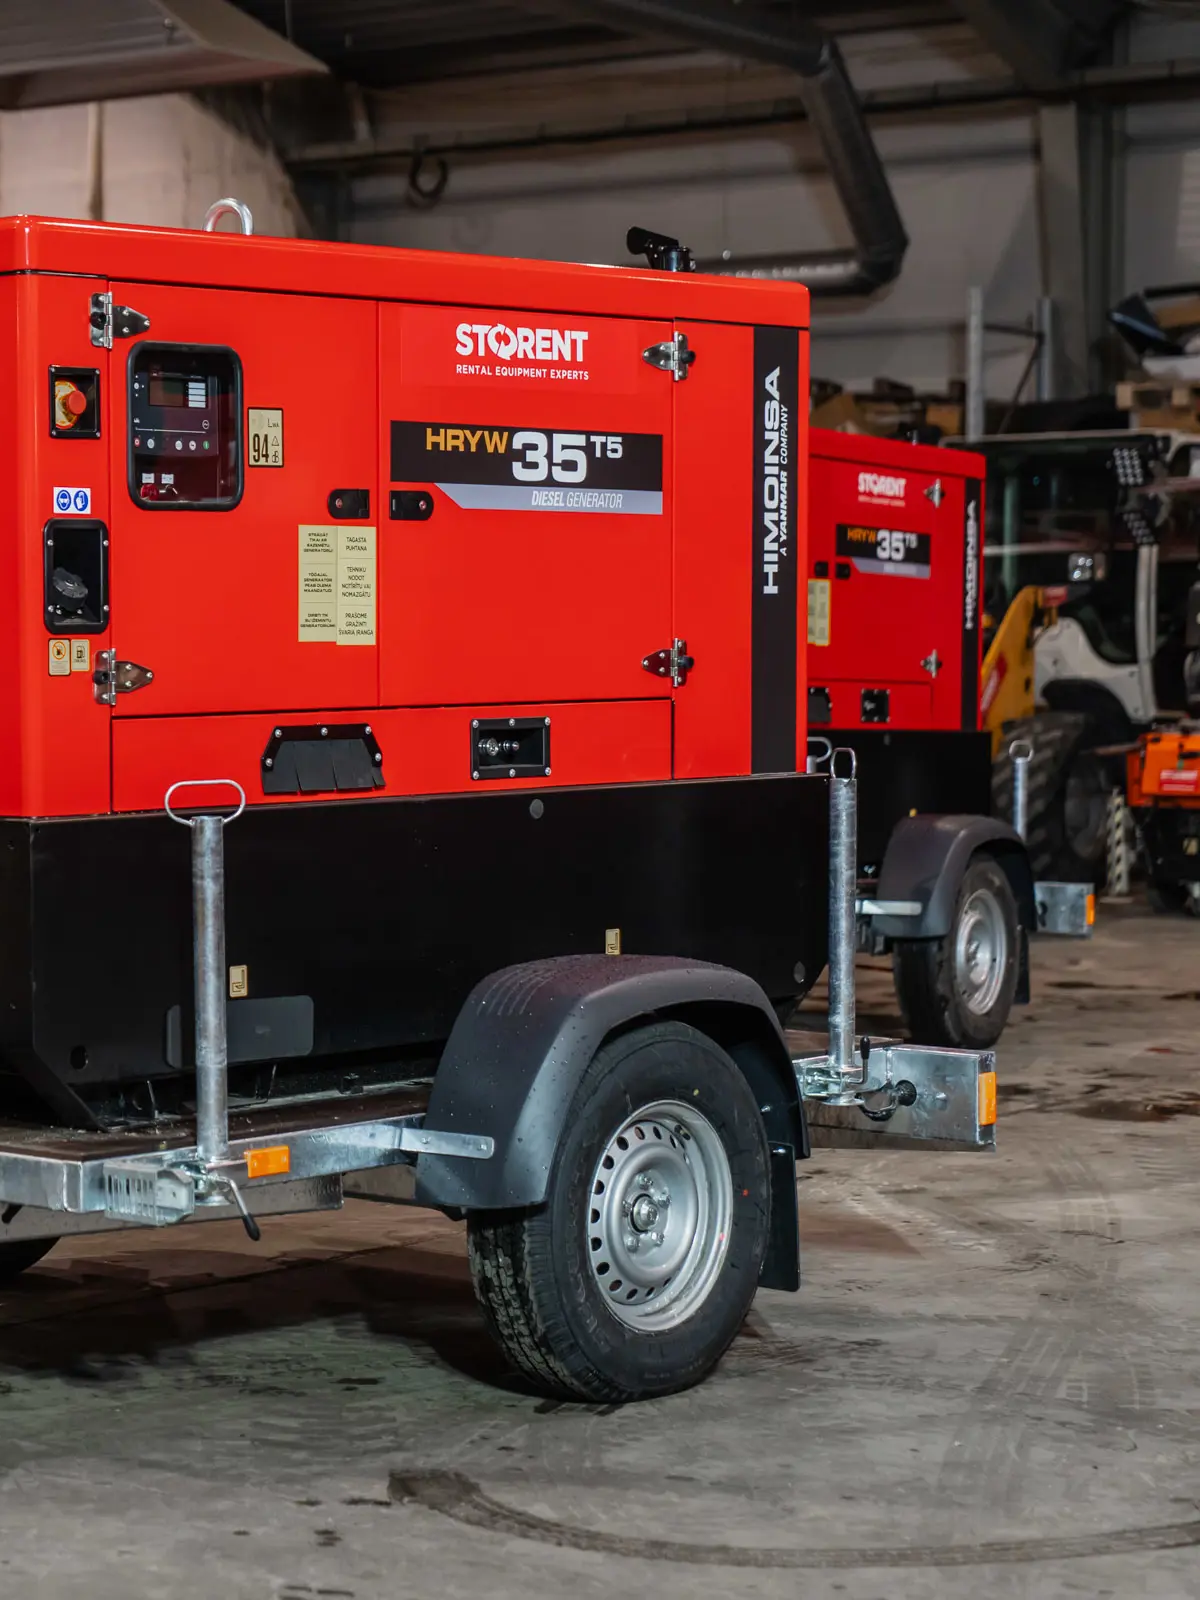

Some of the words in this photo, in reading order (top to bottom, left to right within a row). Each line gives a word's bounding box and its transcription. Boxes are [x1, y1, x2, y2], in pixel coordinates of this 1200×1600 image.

[455, 322, 588, 362] STORENT
[456, 364, 492, 376] RENTAL
[495, 366, 547, 379] EQUIPMENT
[550, 369, 589, 381] EXPERTS
[253, 433, 269, 463] 94
[779, 404, 789, 464] COMPANY
[425, 427, 509, 454] HRYW
[511, 431, 588, 484] 35
[589, 435, 623, 459] T5
[531, 490, 565, 507] DIESEL
[566, 492, 623, 509] GENERATOR
[763, 366, 780, 594] HIMOINSA
[779, 470, 788, 543] YANMAR
[876, 528, 906, 561] 35
